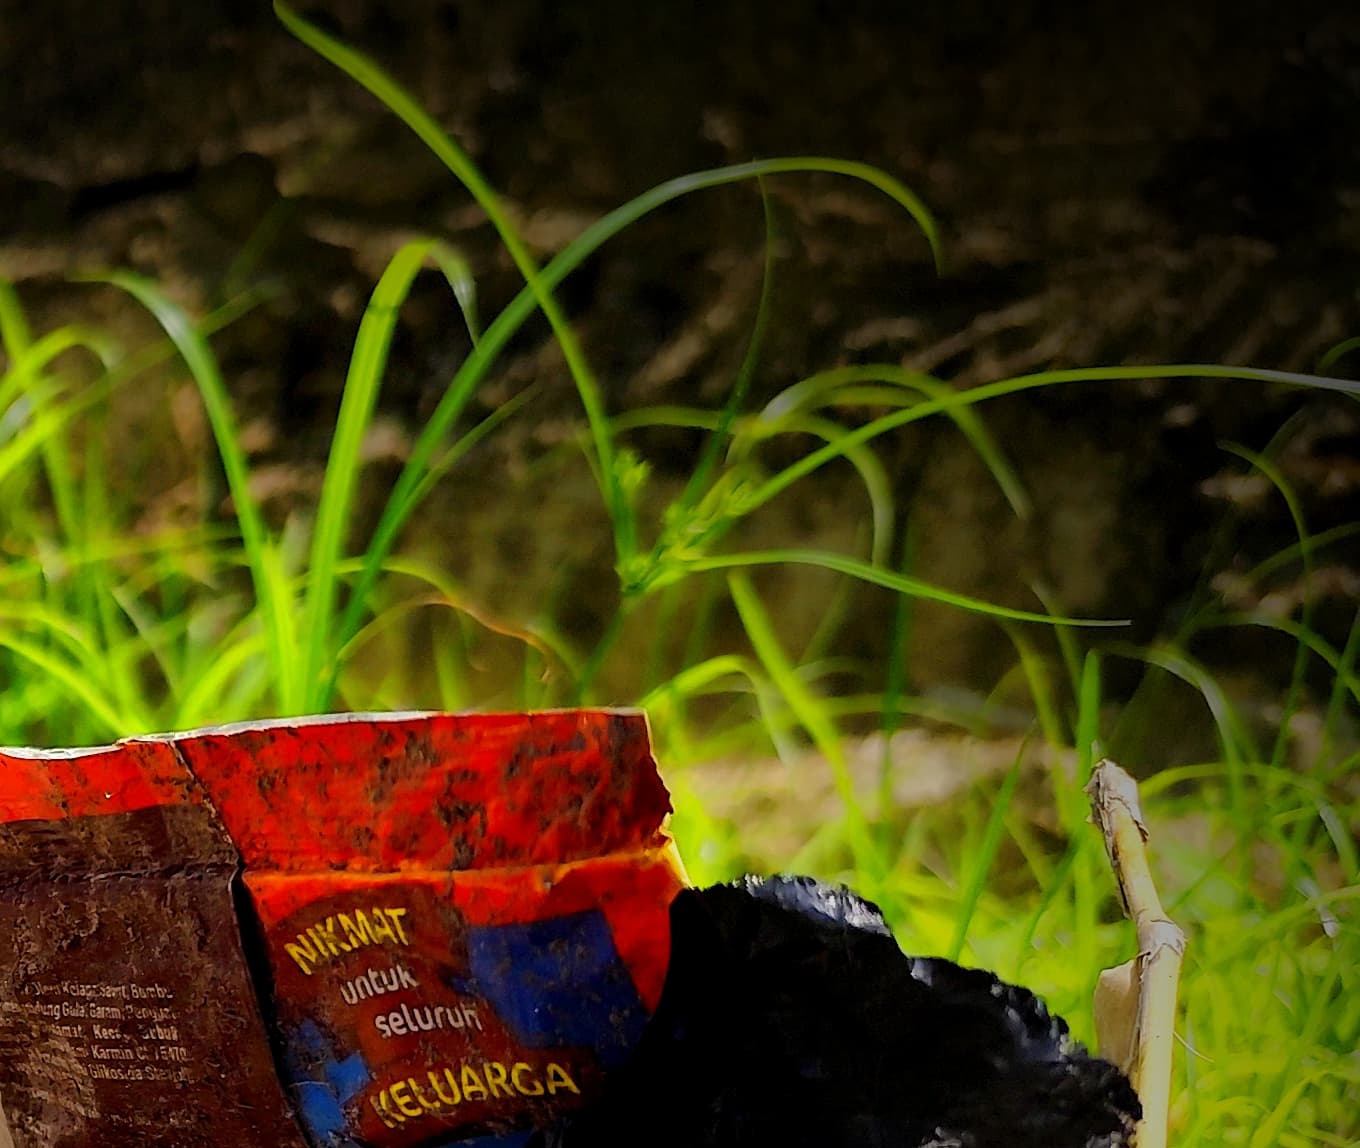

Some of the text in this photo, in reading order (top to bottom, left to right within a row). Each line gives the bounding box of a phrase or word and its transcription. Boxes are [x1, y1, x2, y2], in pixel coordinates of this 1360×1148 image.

[285, 906, 410, 973] NIKMAT
[341, 968, 419, 1006] untuk
[374, 998, 482, 1035] seluruh
[371, 1062, 581, 1130] KELUARGA
